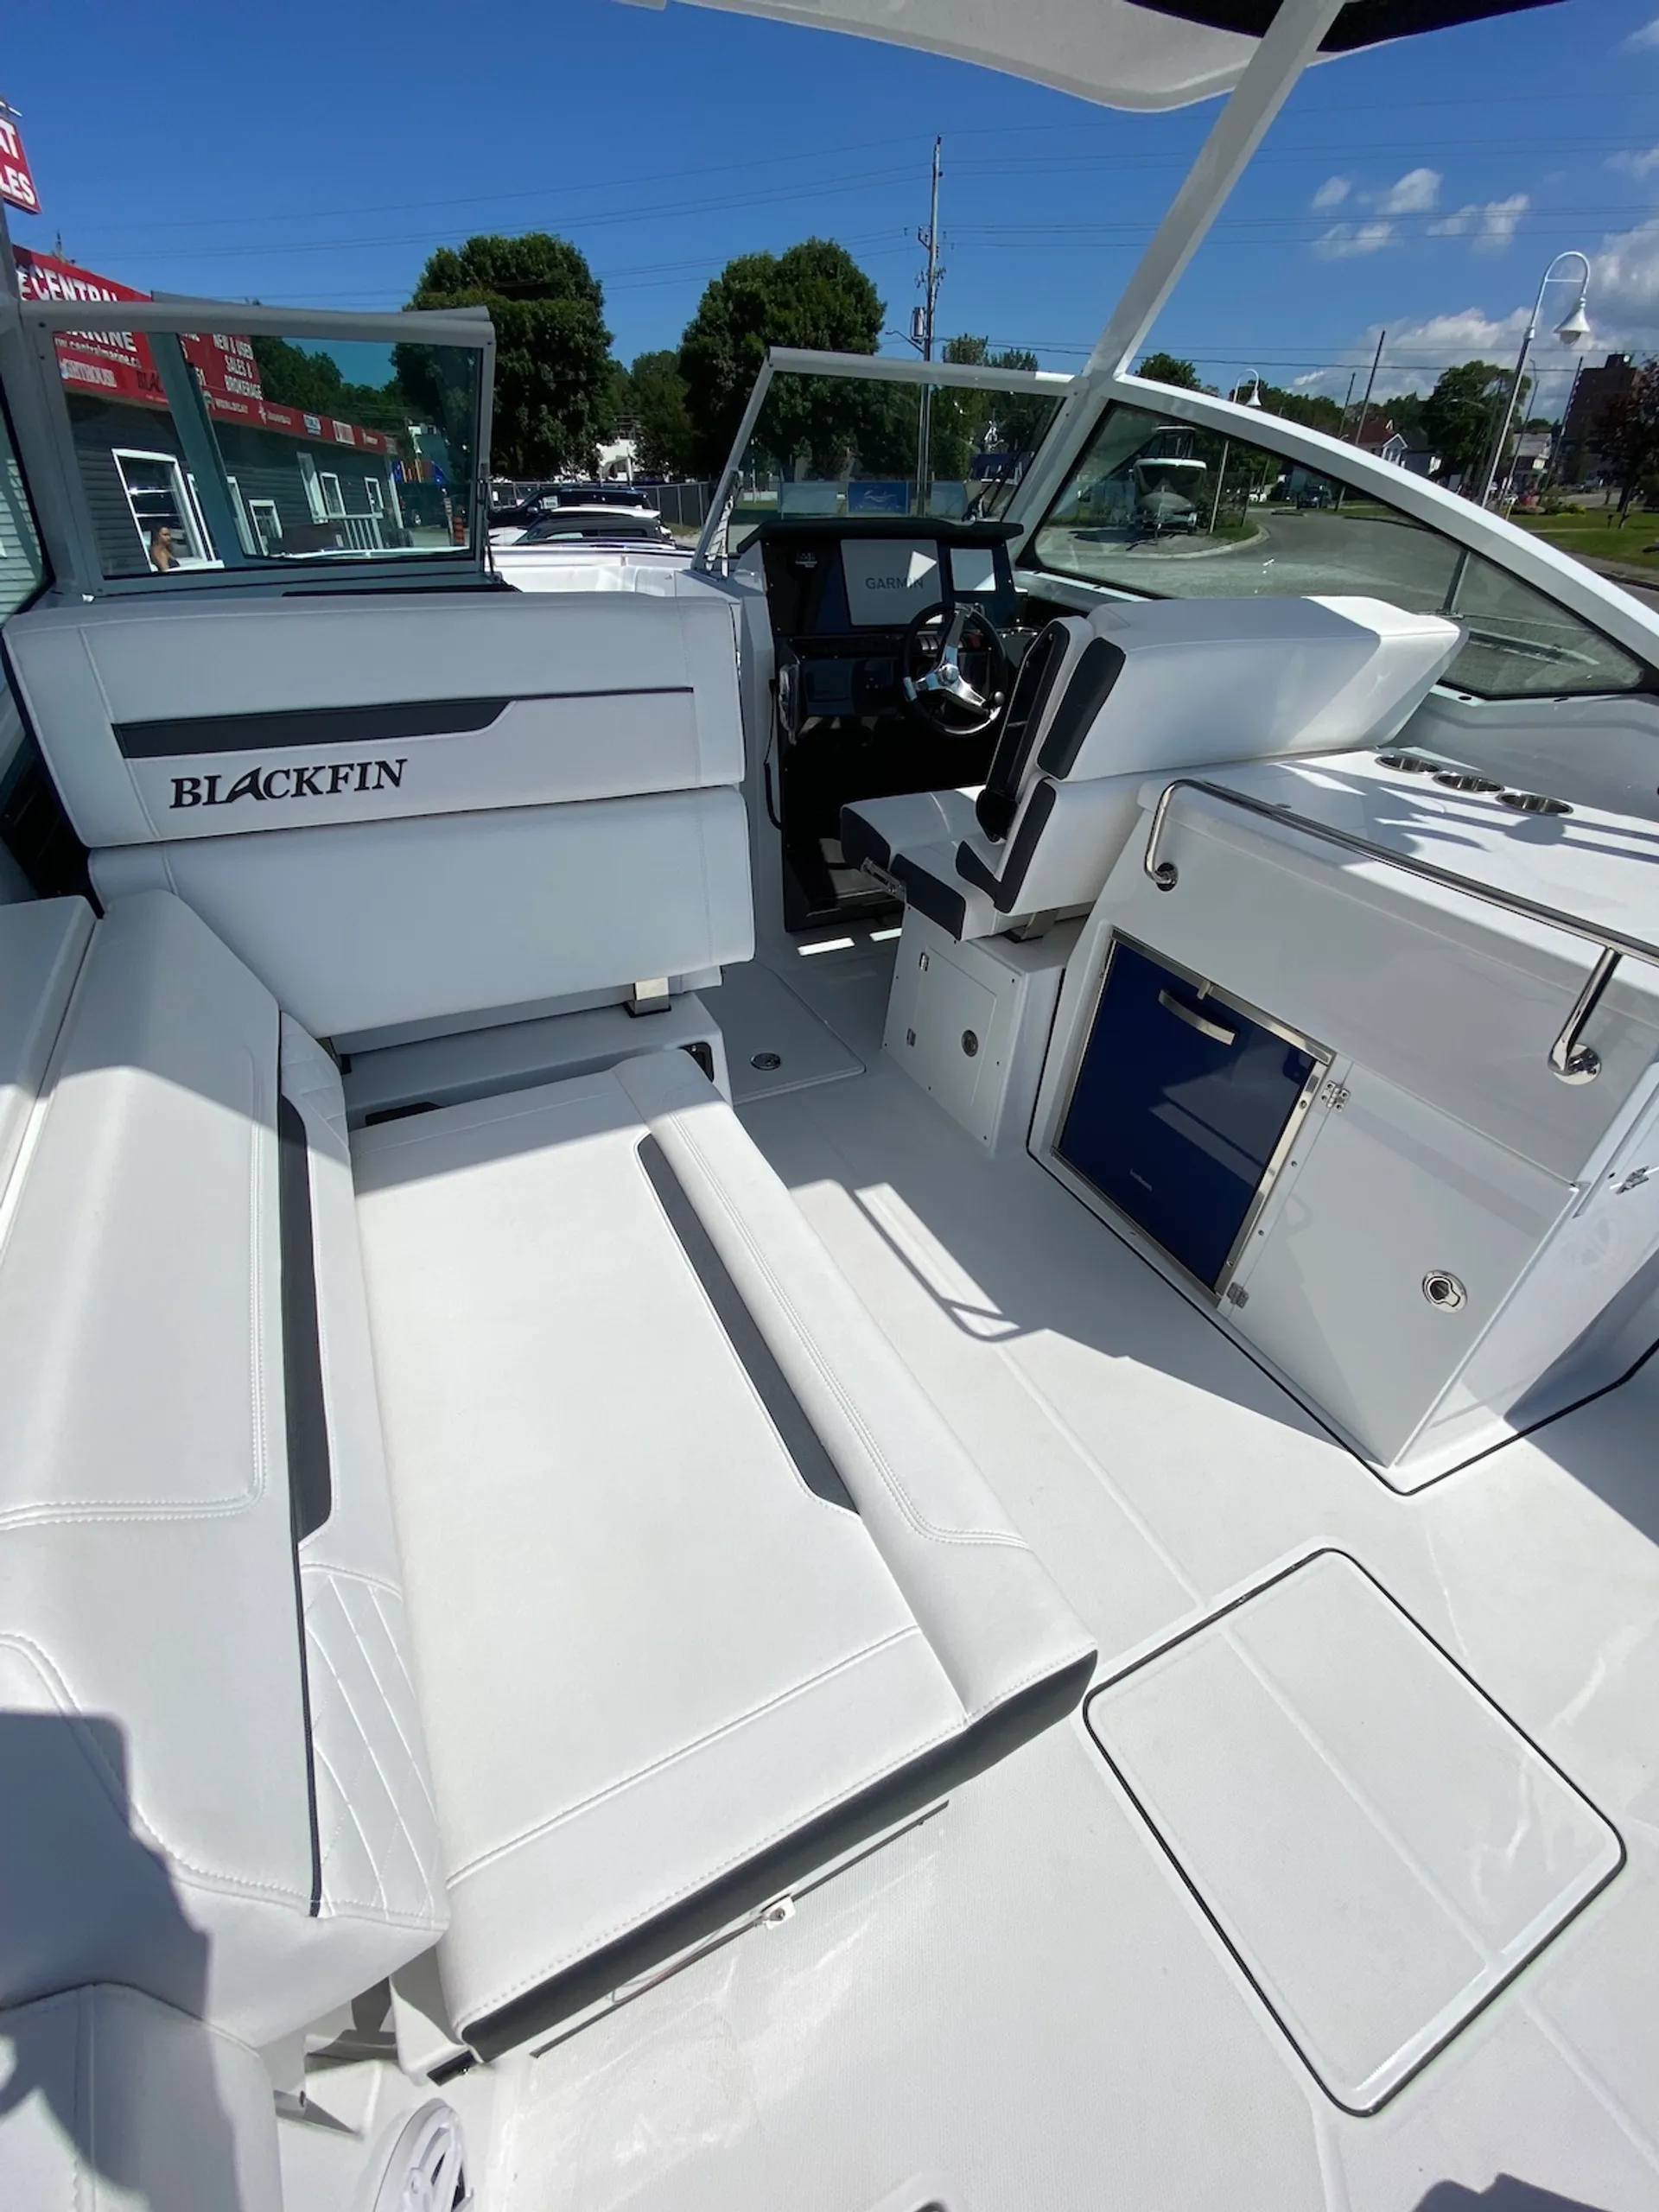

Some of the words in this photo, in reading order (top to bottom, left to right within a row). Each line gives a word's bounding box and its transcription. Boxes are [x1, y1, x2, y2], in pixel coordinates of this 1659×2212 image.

[67, 331, 137, 353] RINE
[865, 576, 924, 589] GARMIN
[169, 759, 408, 809] BLACKFIN
